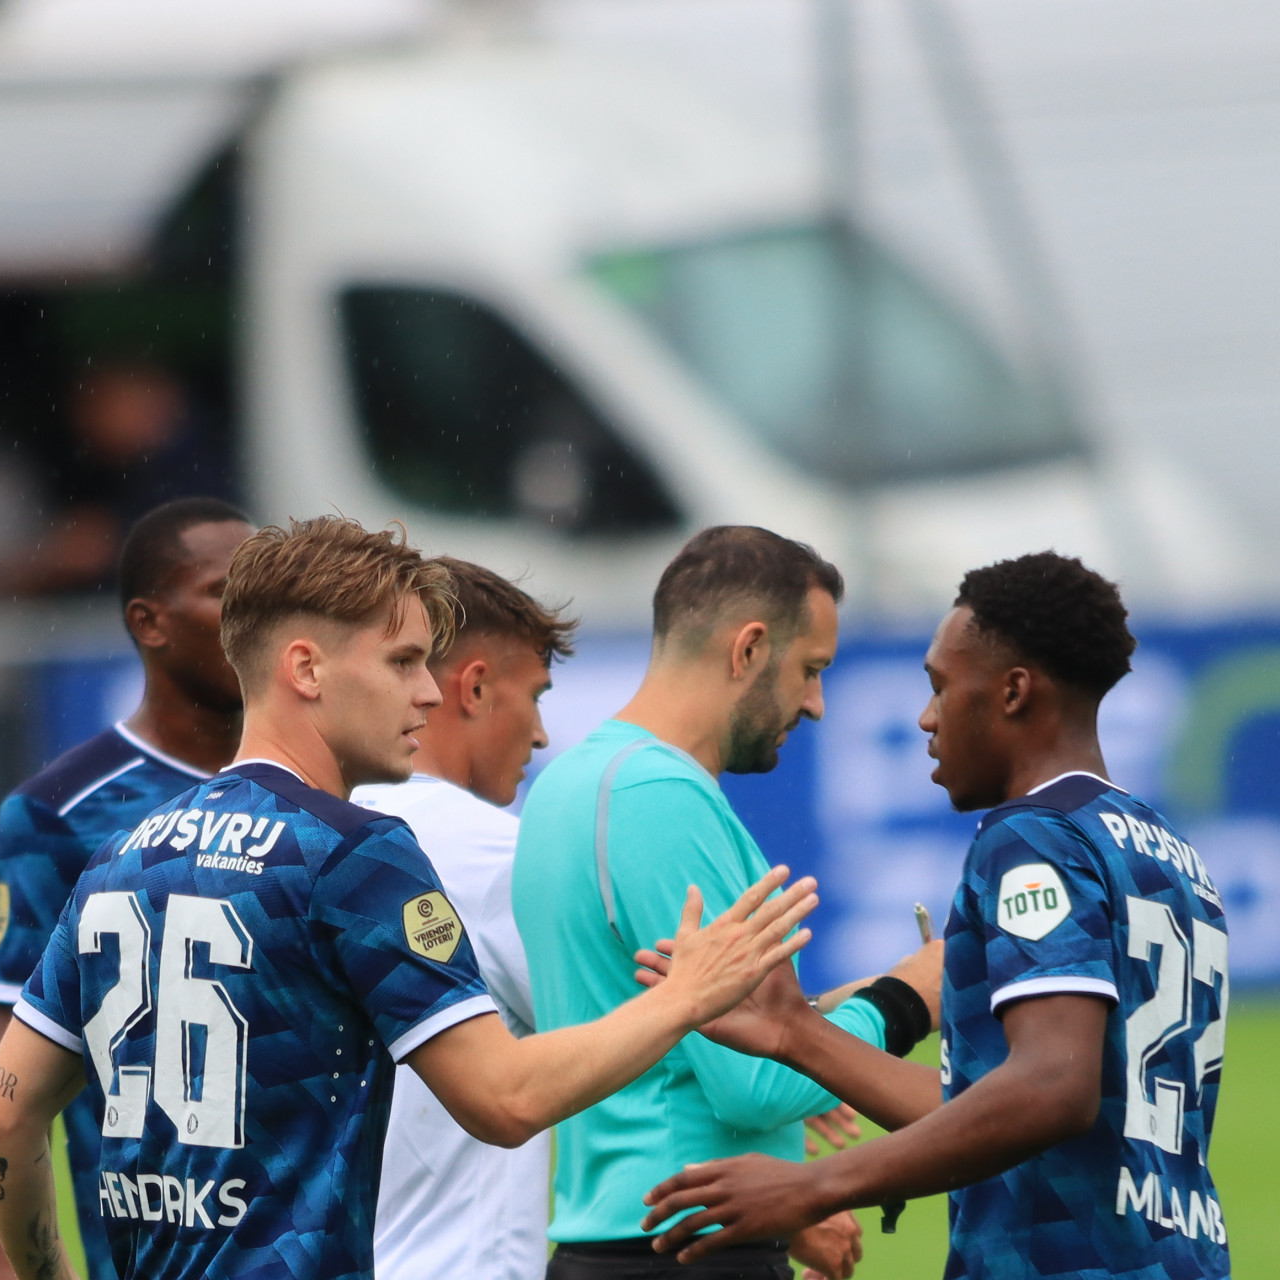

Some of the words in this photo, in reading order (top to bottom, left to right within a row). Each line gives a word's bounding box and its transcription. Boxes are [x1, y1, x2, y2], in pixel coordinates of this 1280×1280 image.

[196, 853, 265, 875] vakanties
[1003, 887, 1058, 920] TOTO
[414, 920, 455, 943] VRIENDEN
[423, 931, 454, 952] LOTERIJ
[78, 891, 254, 1149] 26
